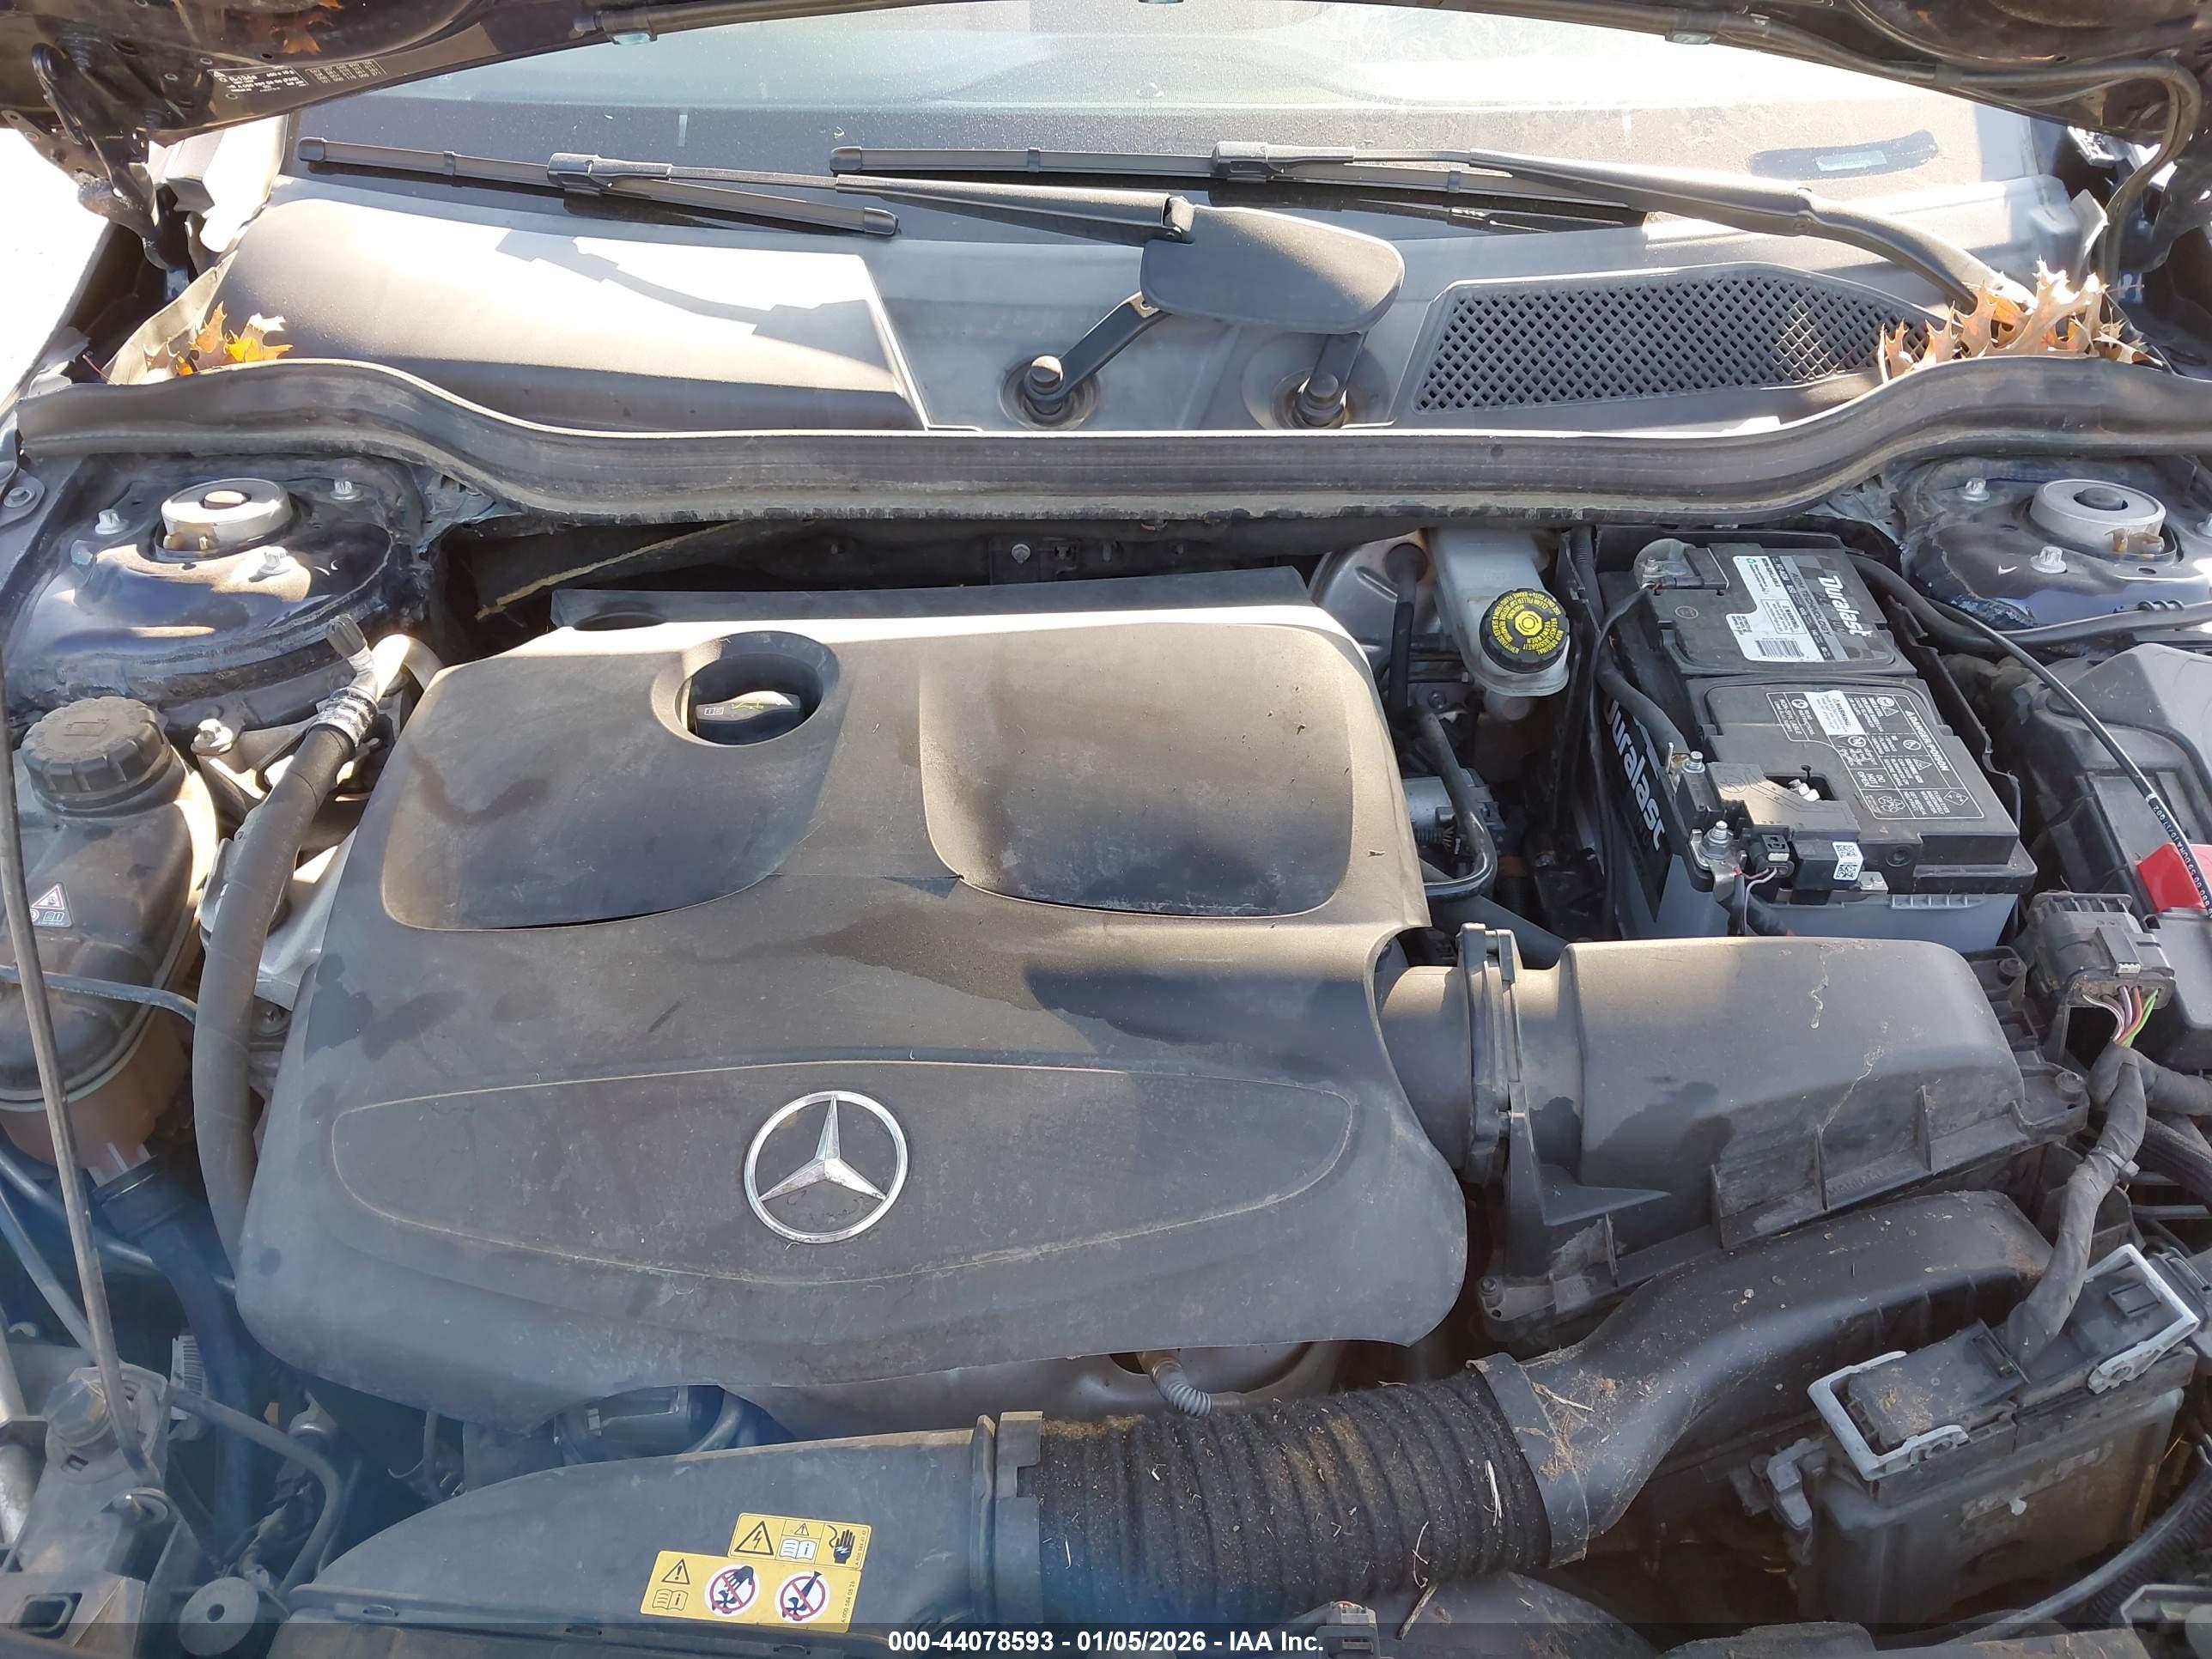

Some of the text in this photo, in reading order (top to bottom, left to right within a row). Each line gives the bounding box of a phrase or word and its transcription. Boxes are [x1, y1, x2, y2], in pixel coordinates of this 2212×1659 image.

[1534, 599, 1547, 609] CLEAN
[1553, 606, 1561, 615] USE
[1818, 575, 1873, 636] Duralast
[1802, 590, 1832, 635] TECHNOLOGY
[1536, 640, 1558, 654] ORIGINAL
[1909, 716, 1948, 771] DANGER/POISON
[1866, 774, 1878, 784] NOT
